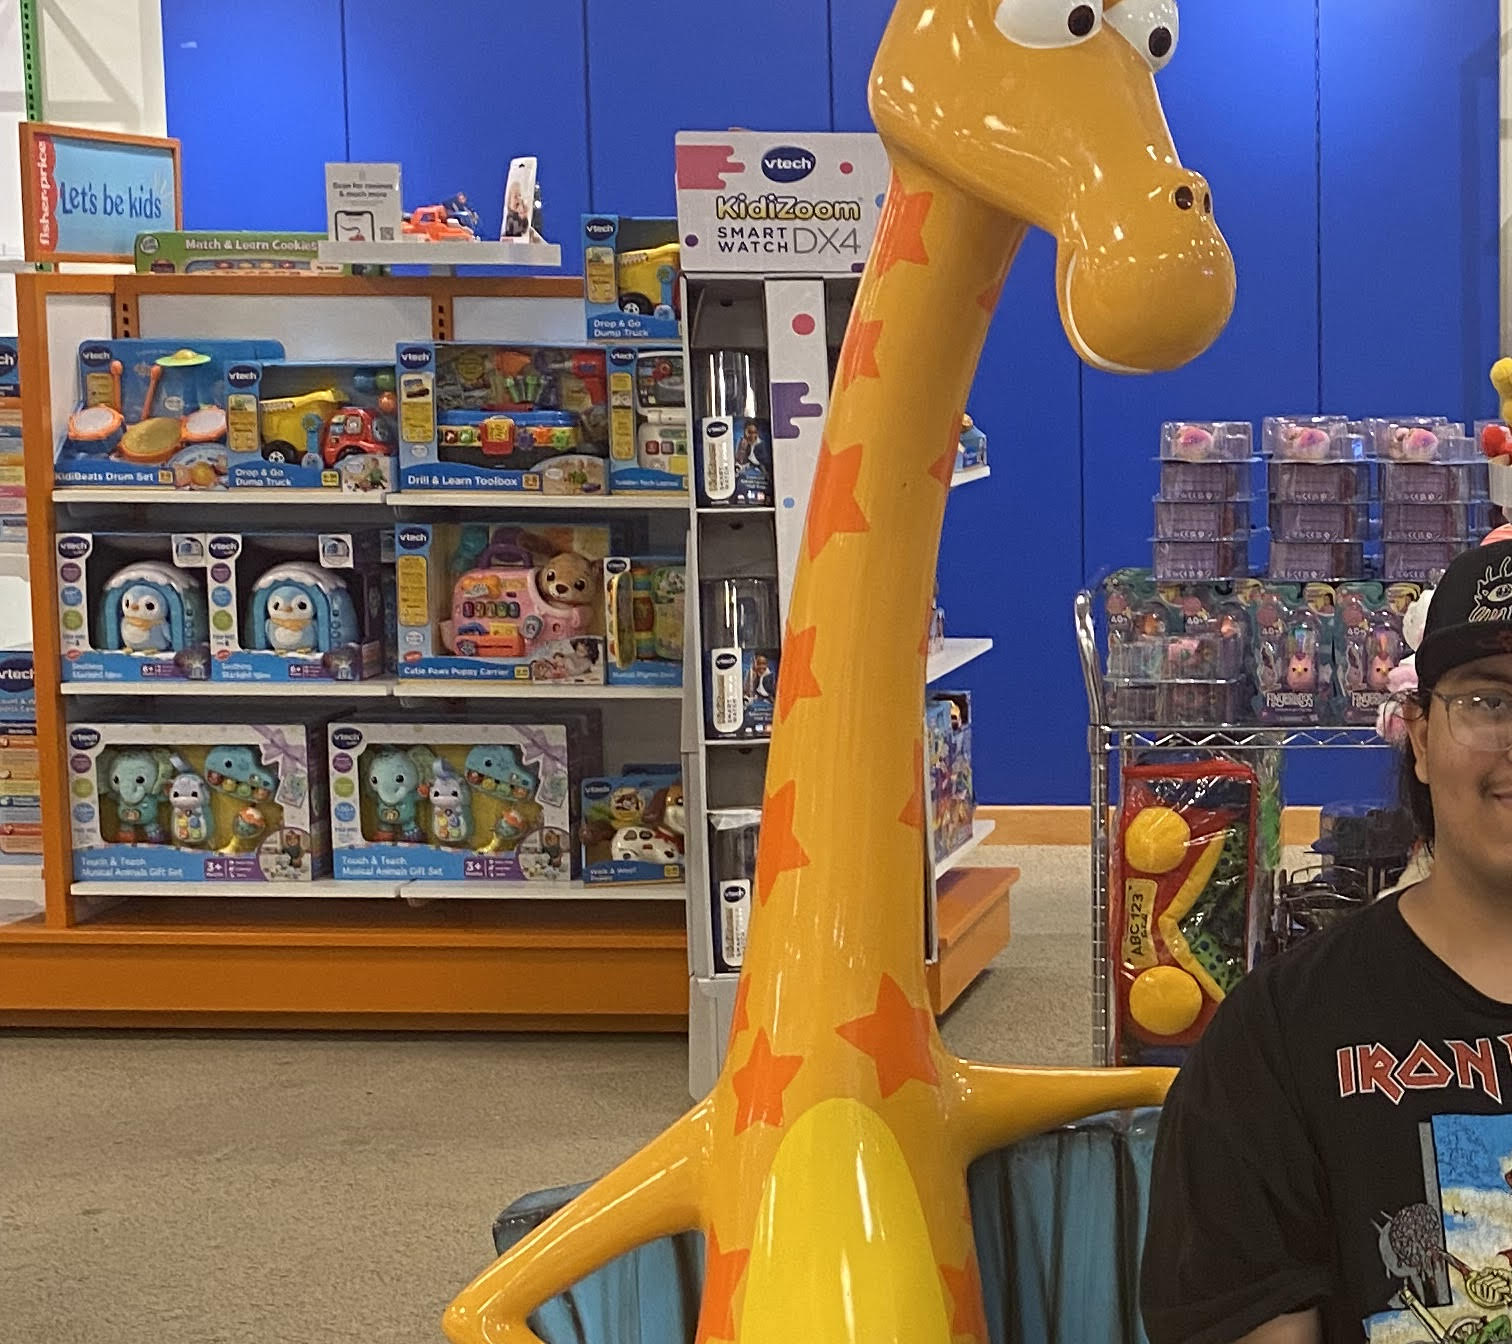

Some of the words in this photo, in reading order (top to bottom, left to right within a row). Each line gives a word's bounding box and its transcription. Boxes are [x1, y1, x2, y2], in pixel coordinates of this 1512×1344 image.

[764, 157, 812, 170] vtech
[59, 182, 97, 215] Let's
[103, 183, 124, 216] be
[129, 185, 162, 219] kids
[716, 192, 861, 221] KidiZoom
[185, 238, 221, 250] Match
[223, 239, 233, 250] &
[235, 239, 270, 250] Learn
[272, 239, 319, 251] Cookies
[717, 227, 788, 239] SMART
[793, 227, 861, 255] DX4
[718, 241, 789, 253] WATCH
[401, 351, 430, 362] vtech
[407, 475, 430, 486] Drill
[431, 475, 440, 486] &
[442, 475, 473, 486] Learn
[475, 475, 518, 487] Toolbox
[1130, 893, 1144, 920] 123
[1129, 922, 1144, 956] ABC
[1336, 1038, 1502, 1104] IRON
